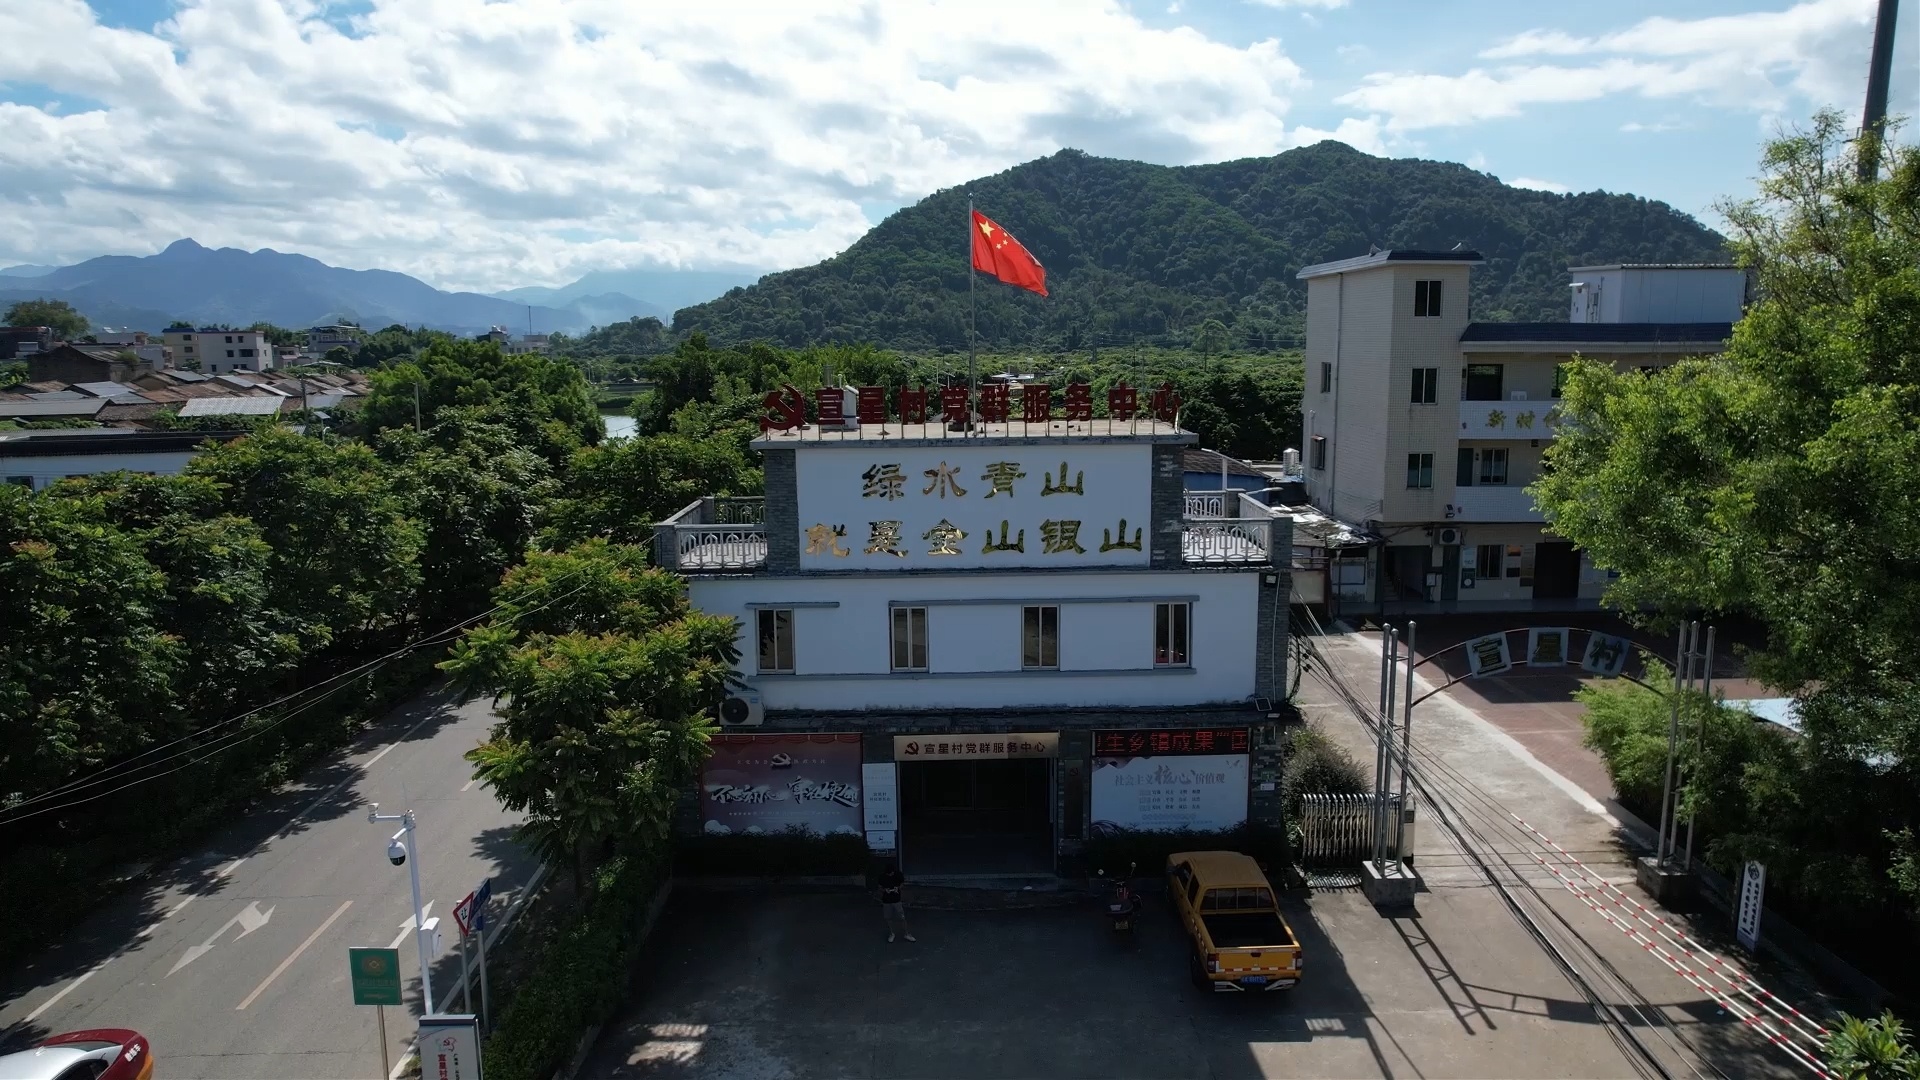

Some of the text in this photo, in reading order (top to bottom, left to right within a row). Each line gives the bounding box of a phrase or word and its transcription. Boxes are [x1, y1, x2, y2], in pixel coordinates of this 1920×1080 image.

[816, 383, 1181, 425] 宣星村党群服务中心
[862, 460, 1084, 500] 绿水青山
[804, 518, 1142, 557] 就是金山银山
[923, 741, 1046, 755] 宣星村党群服务中心
[1115, 764, 1226, 786] 社会主义核心价值观
